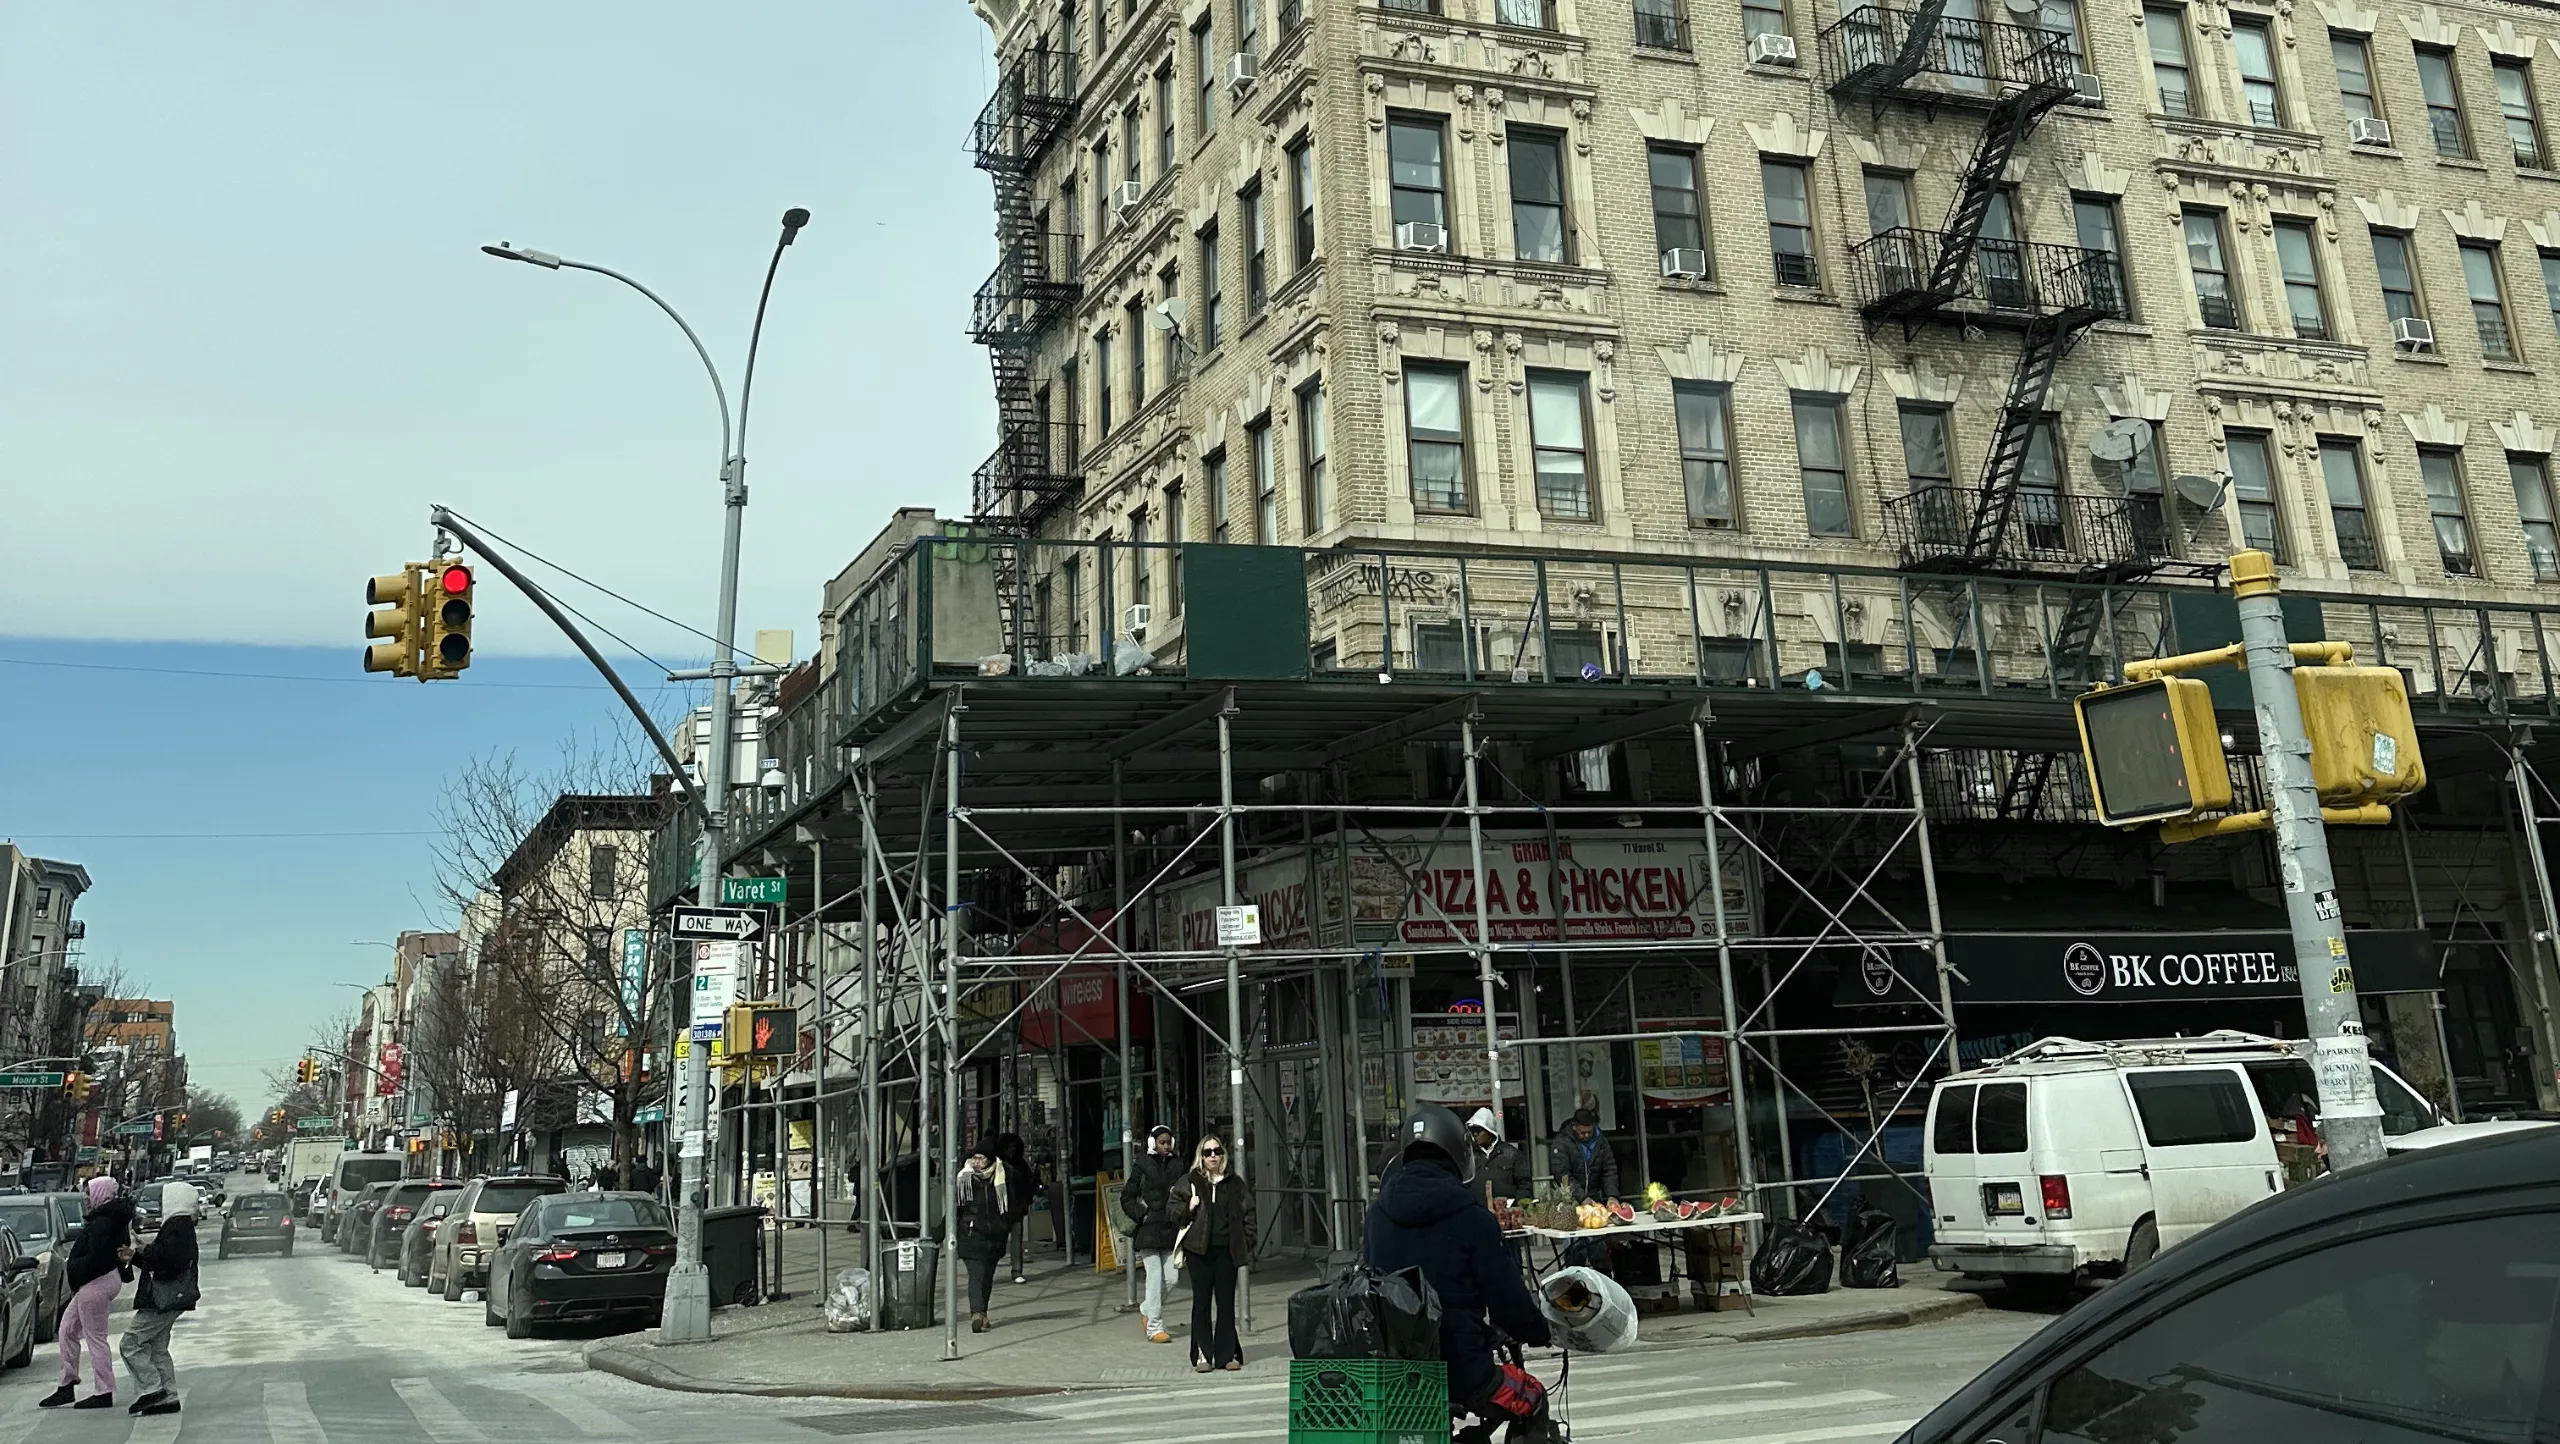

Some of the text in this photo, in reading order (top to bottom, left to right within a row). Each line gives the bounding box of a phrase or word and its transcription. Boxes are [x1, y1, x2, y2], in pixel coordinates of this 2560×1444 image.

[1512, 842, 1572, 863] GRAHM
[1622, 843, 1631, 853] 77
[1632, 843, 1655, 853] Varet
[729, 881, 781, 899] Varet St
[1412, 868, 1690, 914] PIZZA & CHICKEN
[687, 917, 752, 932] ONE WAY
[1183, 909, 1217, 950] PIZZ
[2109, 952, 2281, 987] BK COFFEE
[698, 977, 706, 990] 2
[1061, 978, 1103, 1006] wireless
[2324, 1063, 2360, 1072] SUNDAY
[12, 1075, 48, 1084] Moore St
